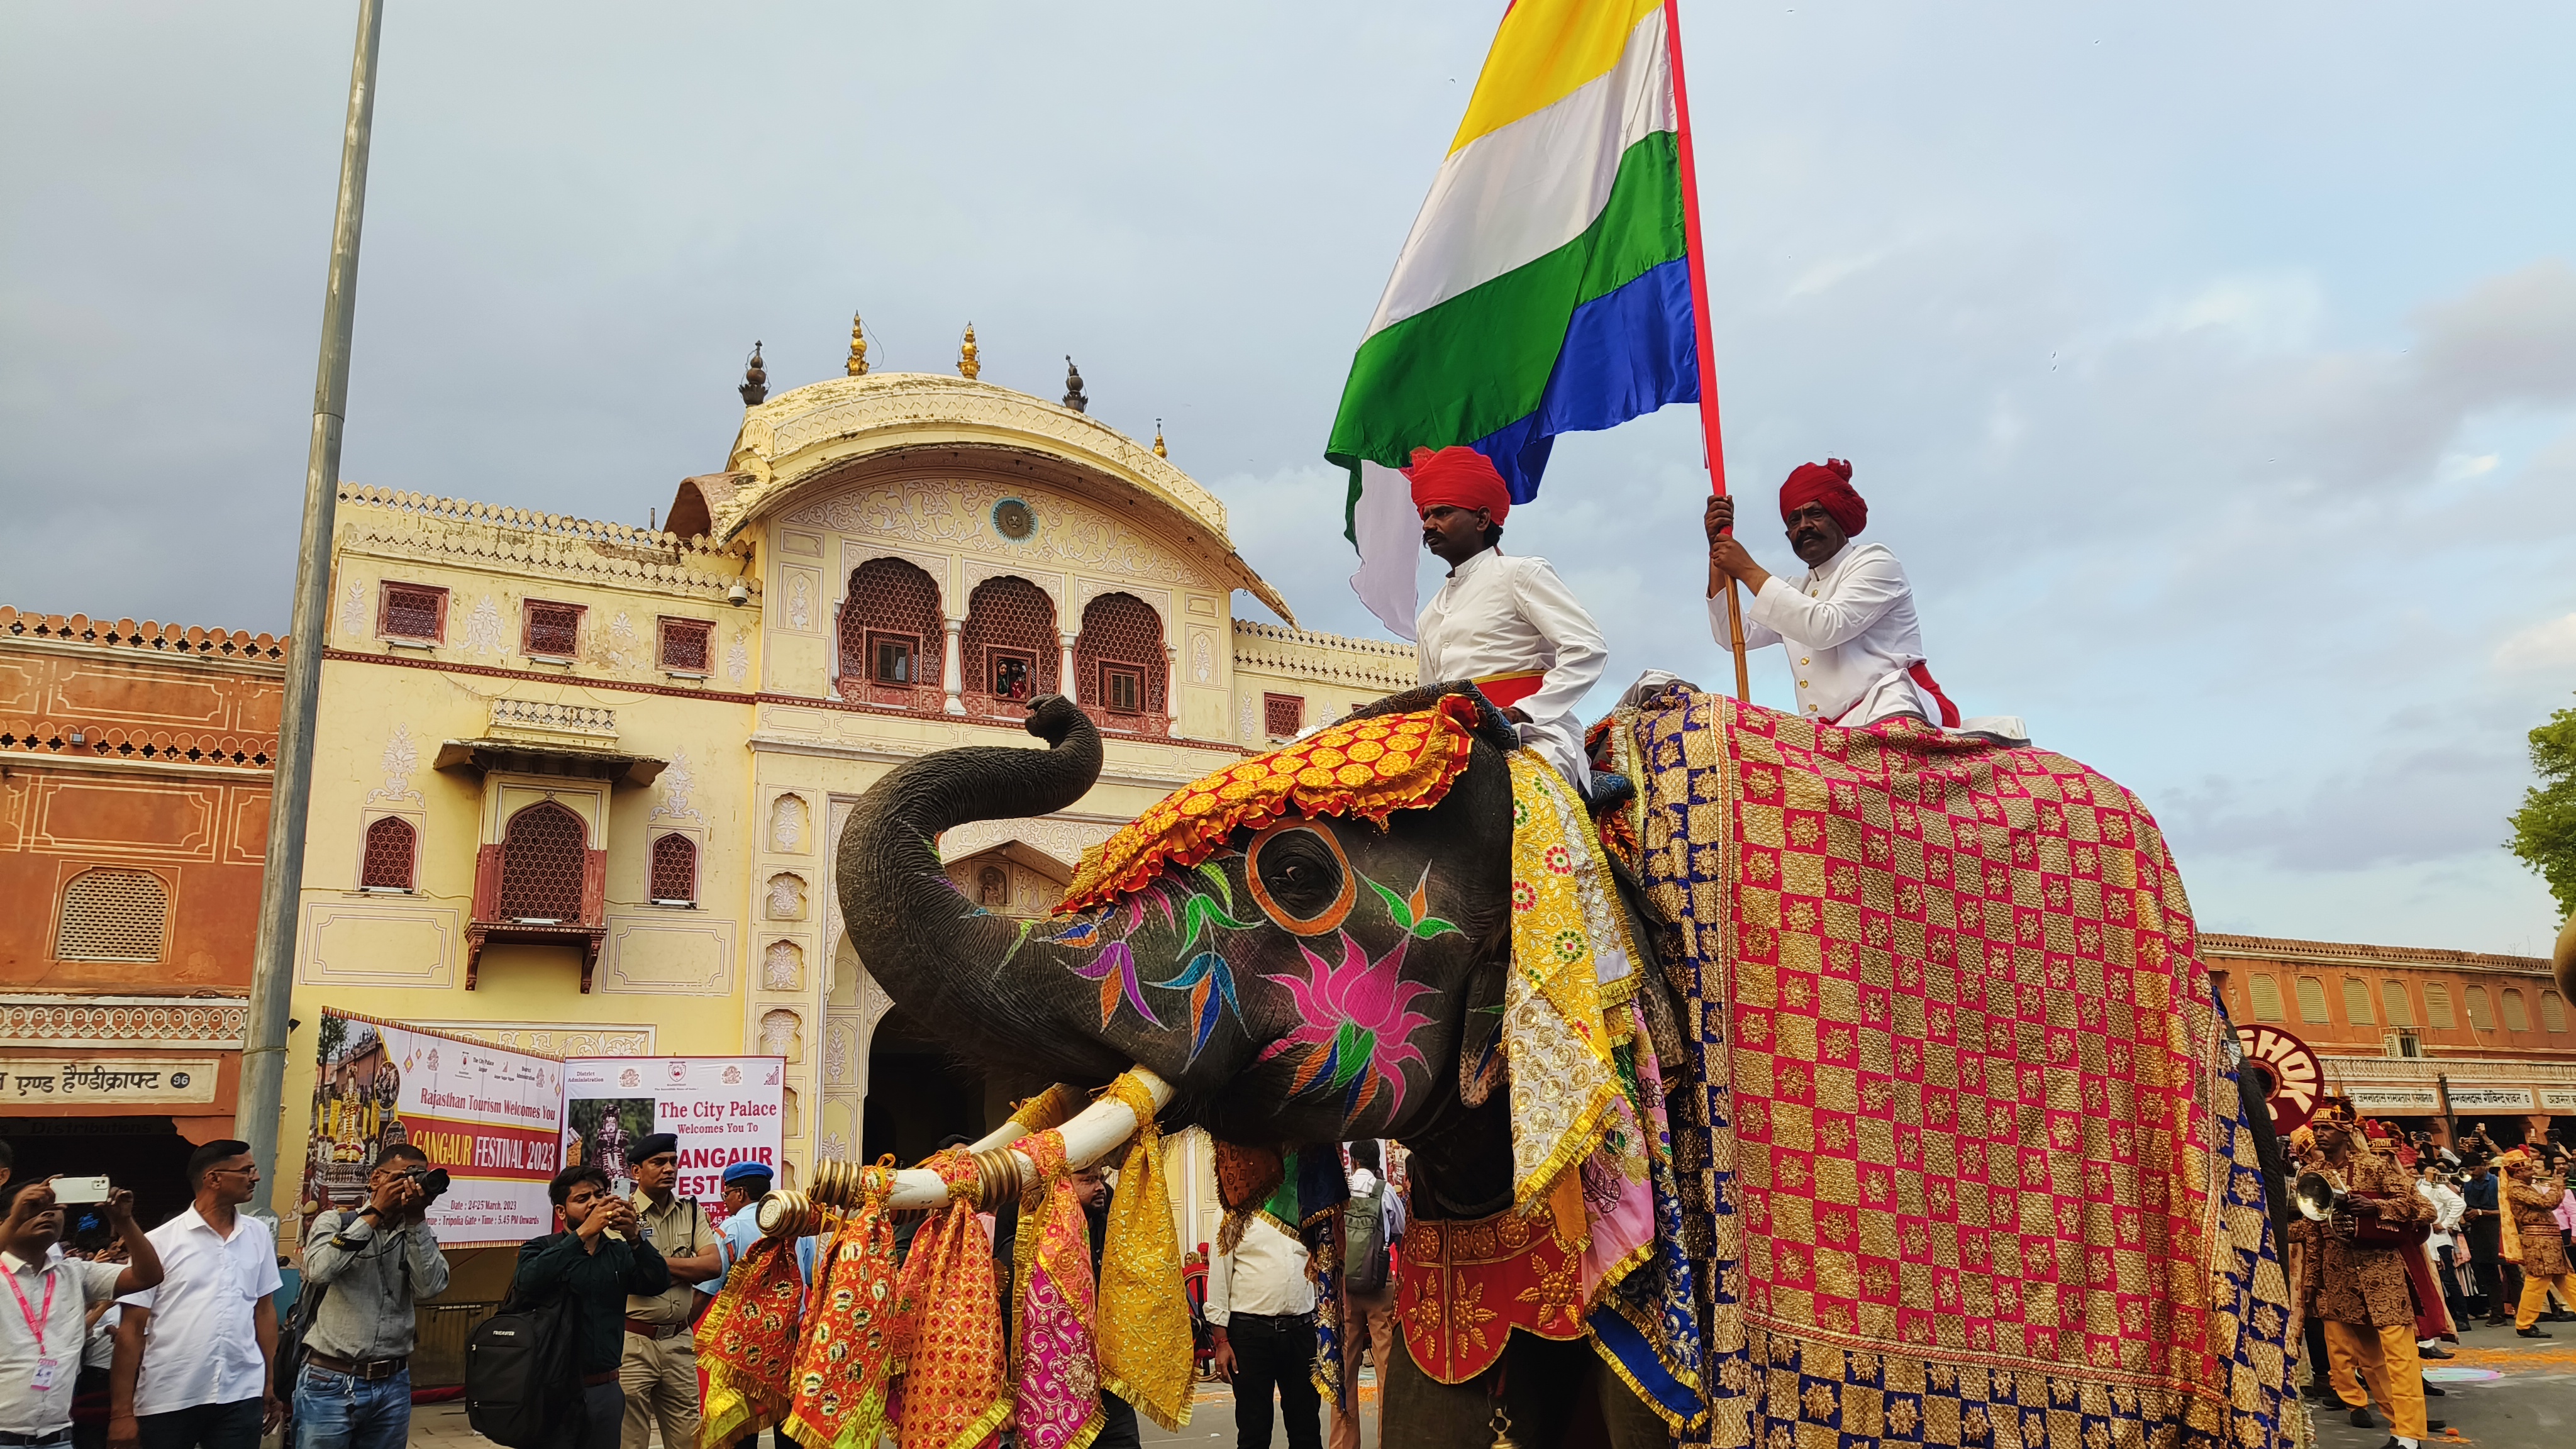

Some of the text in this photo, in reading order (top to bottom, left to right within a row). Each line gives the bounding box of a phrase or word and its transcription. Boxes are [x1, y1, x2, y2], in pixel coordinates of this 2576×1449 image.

[15, 1076, 55, 1096] एण्ड
[62, 1064, 161, 1093] हैण्डीक्राफ्ट
[173, 1075, 189, 1086] 96
[420, 1087, 555, 1121] Rajasthan Tourism Welcomes You
[660, 1101, 777, 1121] The City Palace
[677, 1123, 758, 1135] Welcomes You To
[413, 1130, 555, 1172] GANGAUR FESTIVAL 2023
[450, 1200, 464, 1211] Date
[503, 1200, 517, 1211] 2023
[443, 1215, 464, 1228] Tripolia
[465, 1216, 477, 1226] Gate
[482, 1215, 494, 1225] Time
[498, 1215, 509, 1225] 5.45
[511, 1216, 518, 1225] PM
[519, 1215, 539, 1225] Onwards
